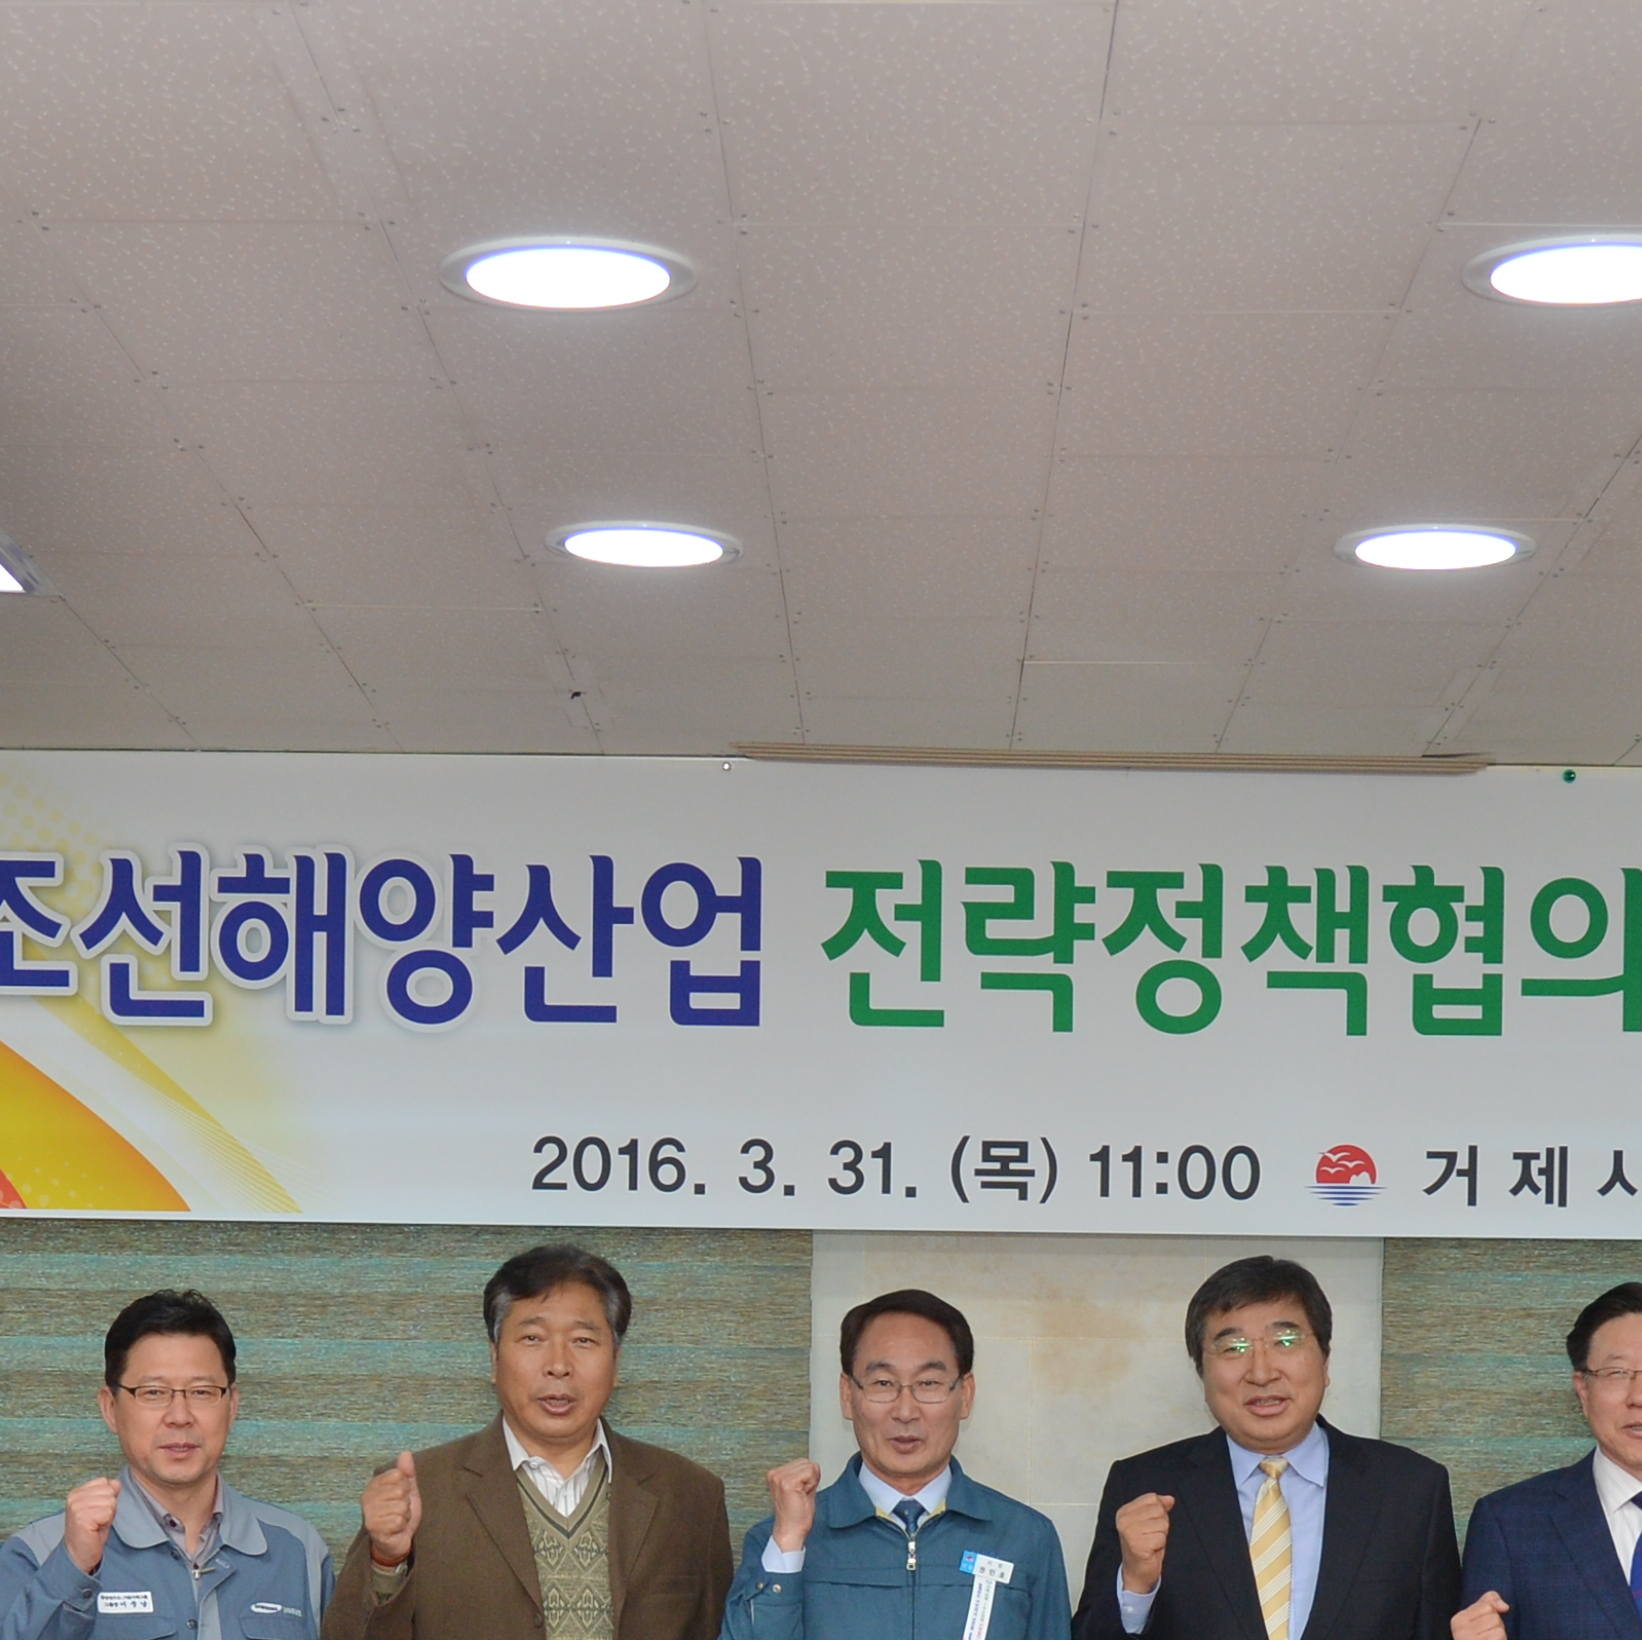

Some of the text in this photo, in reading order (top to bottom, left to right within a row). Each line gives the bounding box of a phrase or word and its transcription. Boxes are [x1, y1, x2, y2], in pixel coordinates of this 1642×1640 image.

[531, 1135, 1261, 1204] 2016. 3. 31. (목) 11:00
